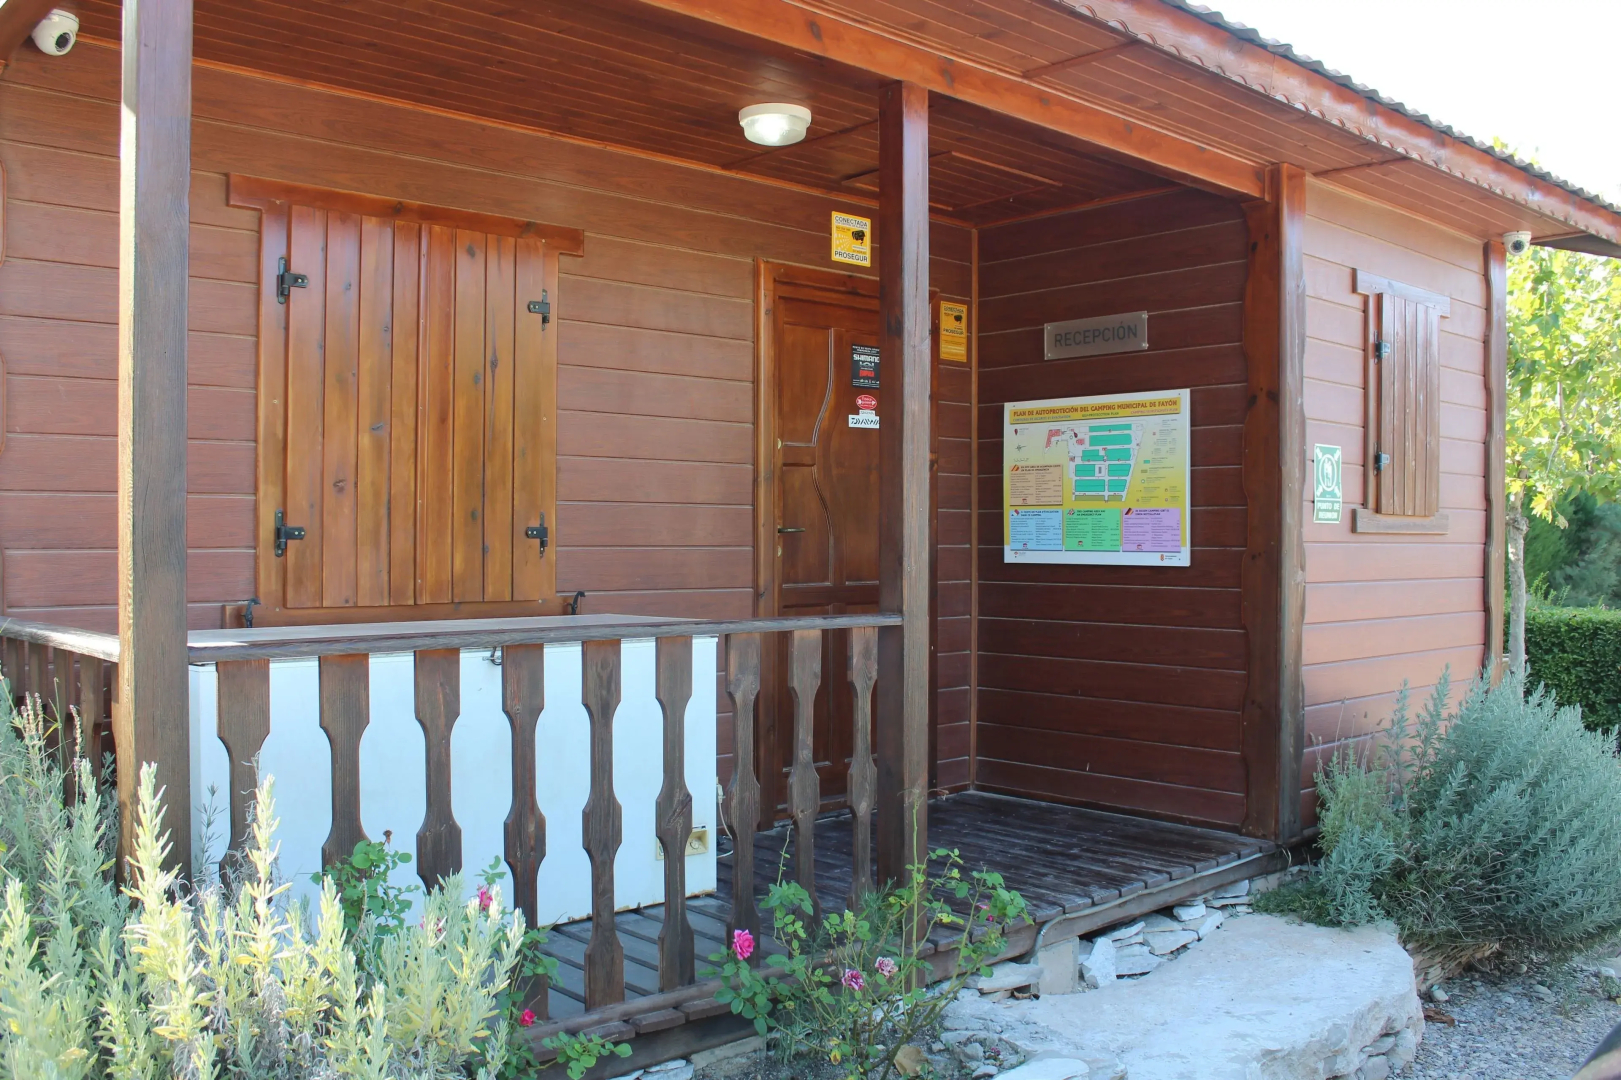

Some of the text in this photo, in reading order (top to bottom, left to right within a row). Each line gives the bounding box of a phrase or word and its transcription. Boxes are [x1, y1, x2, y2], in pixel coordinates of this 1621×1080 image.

[835, 215, 868, 227] CONECTADA
[835, 250, 868, 262] PROSEGUR
[1054, 321, 1138, 348] RECEPCIÓN
[1091, 404, 1116, 412] CAMPING
[1117, 402, 1148, 410] MUNICIPAL
[1158, 399, 1178, 407] FAYÓN
[1317, 502, 1340, 510] PUNTO DE
